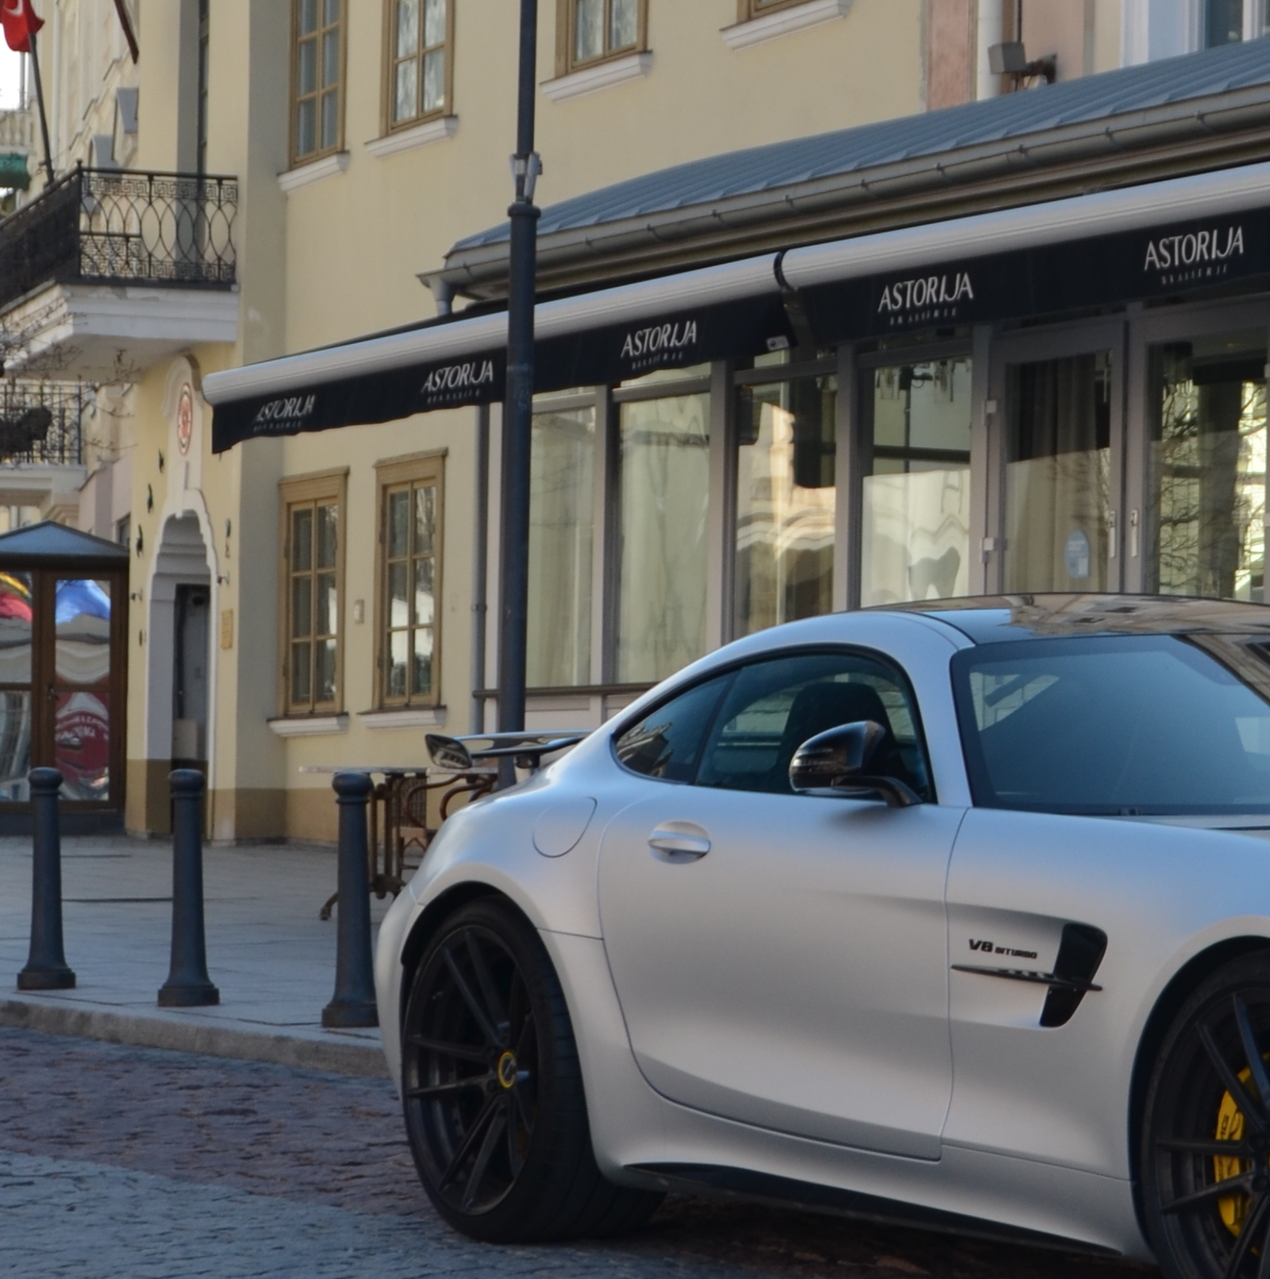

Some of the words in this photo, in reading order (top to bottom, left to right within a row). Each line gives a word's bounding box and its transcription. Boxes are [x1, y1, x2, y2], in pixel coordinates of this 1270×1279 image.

[1144, 226, 1244, 271] ASTORIJA
[878, 272, 974, 312] ASTORIJA
[620, 321, 697, 358] ASTORIJA
[421, 360, 493, 393] ASTORIJA
[968, 938, 994, 953] V8
